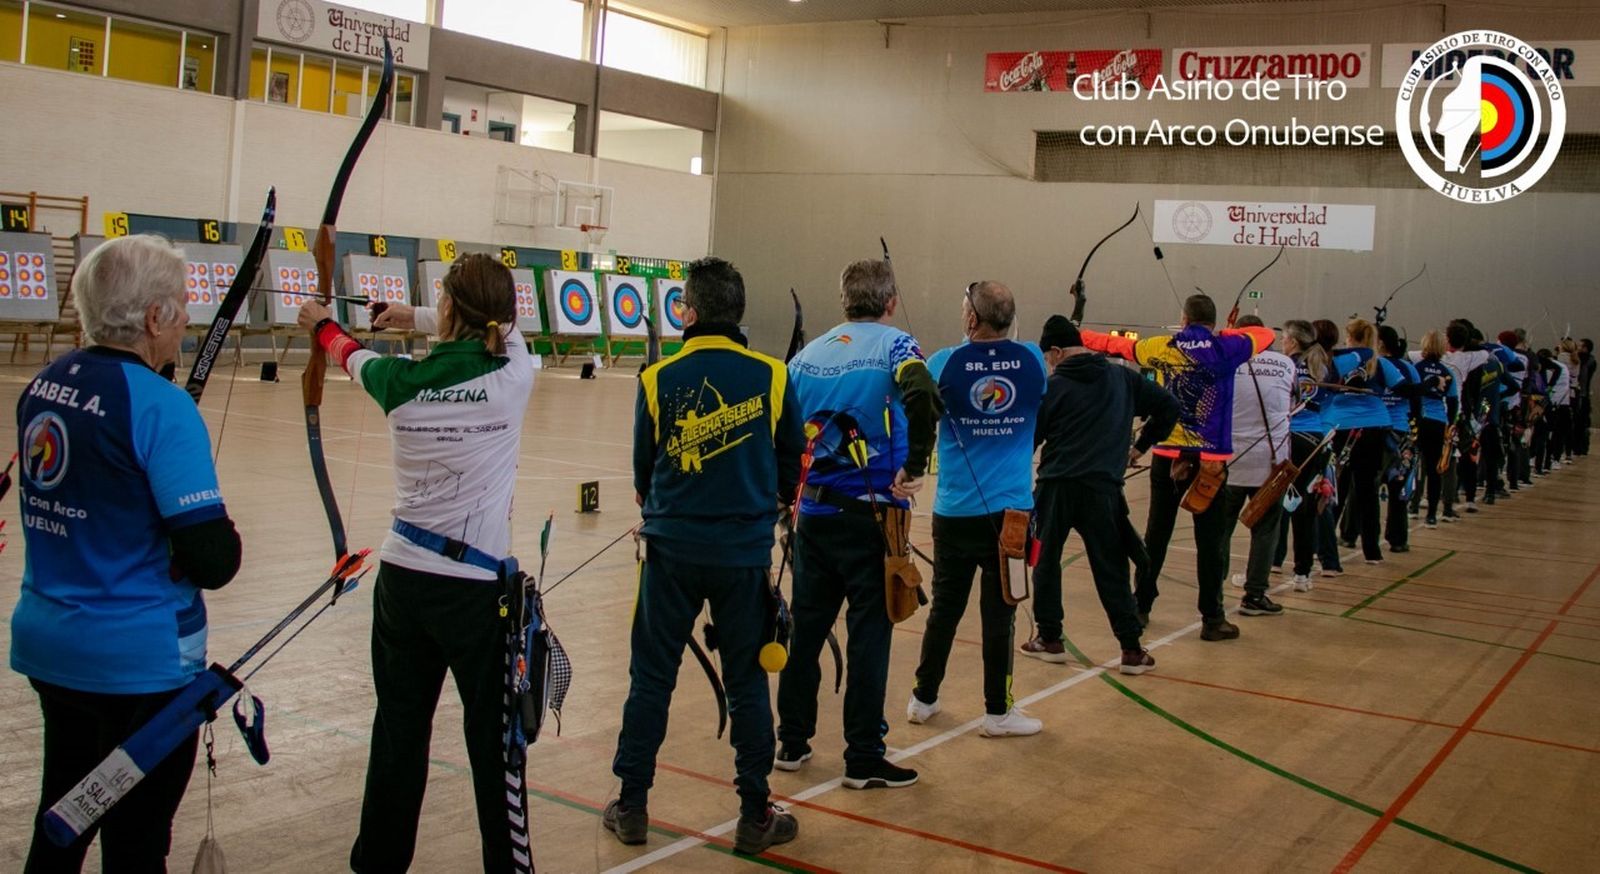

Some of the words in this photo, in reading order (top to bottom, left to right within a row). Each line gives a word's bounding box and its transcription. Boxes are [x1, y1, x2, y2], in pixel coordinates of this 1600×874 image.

[327, 8, 410, 43] Universidad
[332, 31, 351, 52] de
[1179, 51, 1362, 82] Cruzcampo
[9, 209, 28, 229] 14
[1227, 205, 1327, 225] Universidad
[112, 217, 128, 237] 15
[204, 221, 220, 242] 16
[1233, 226, 1255, 245] de
[1259, 227, 1320, 247] Huelva
[291, 231, 307, 248] 17
[374, 236, 387, 255] 18
[443, 242, 456, 259] 19
[502, 250, 517, 268] 20
[563, 252, 577, 269] 21
[617, 259, 630, 275] 22
[193, 317, 230, 381] KINETIC
[965, 361, 988, 371] SR.
[992, 360, 1021, 371] EDU
[415, 388, 489, 402] MARINA
[82, 394, 106, 417] A.
[960, 417, 980, 425] Tiro
[1002, 416, 1025, 424] Arco
[972, 427, 1013, 436] HUELVA
[583, 487, 597, 505] 12
[29, 495, 50, 511] con
[53, 501, 88, 519] Arco
